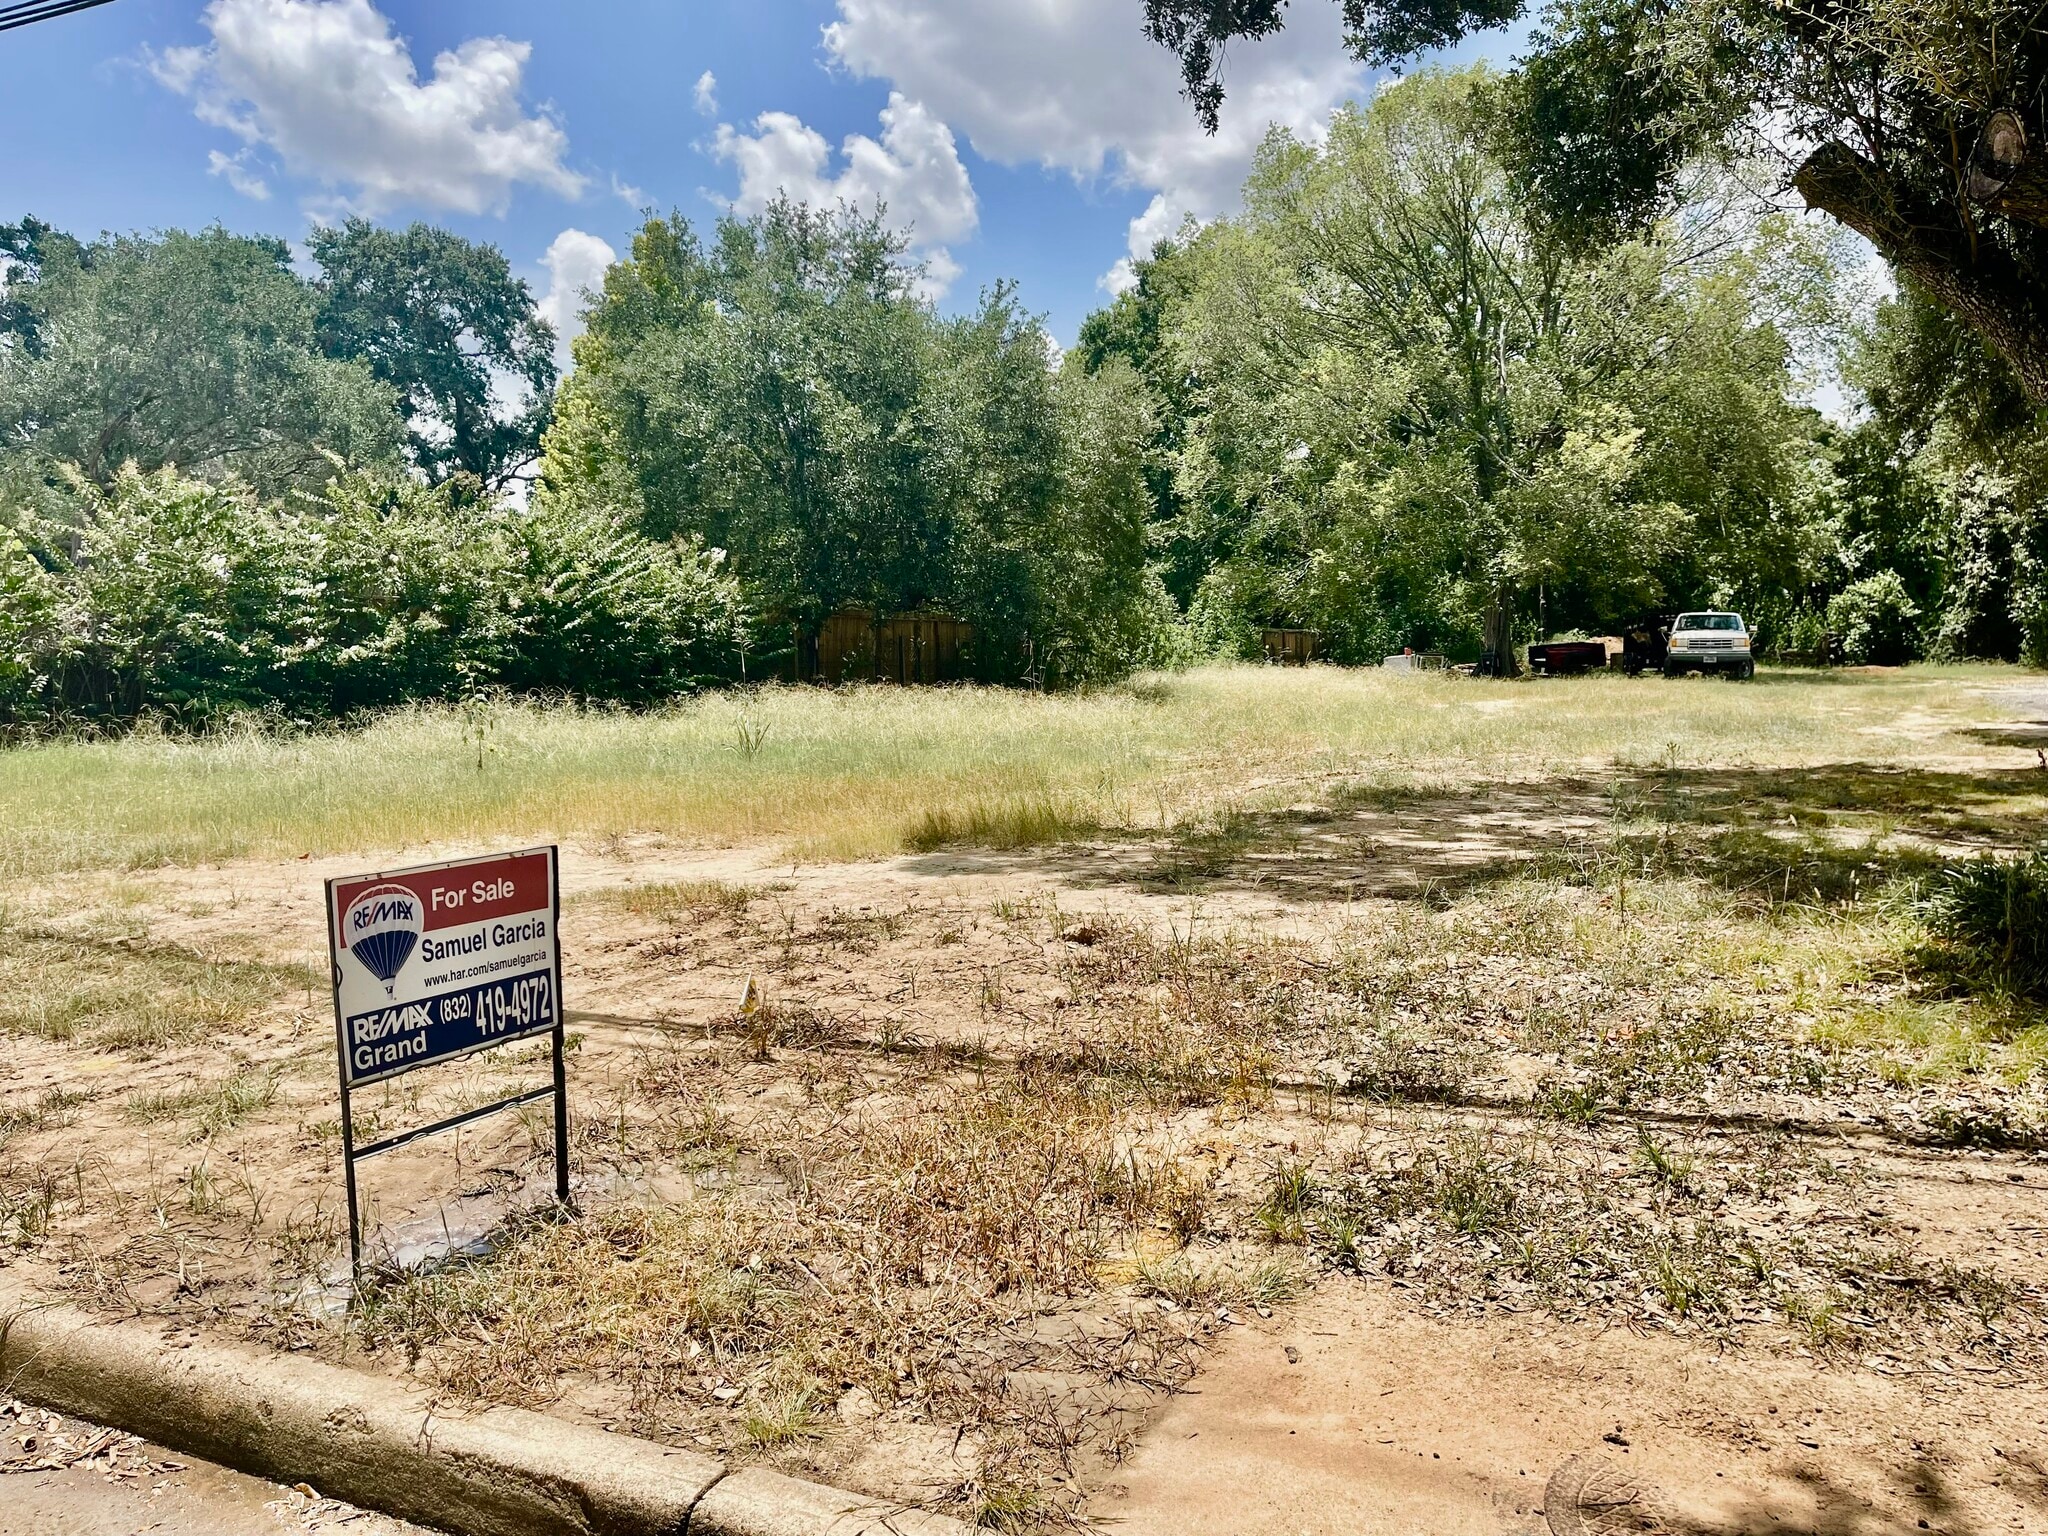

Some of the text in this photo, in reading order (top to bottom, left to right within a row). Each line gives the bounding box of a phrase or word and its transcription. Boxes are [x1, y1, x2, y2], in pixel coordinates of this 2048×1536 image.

[431, 877, 515, 912] For Sale
[353, 900, 414, 931] RE/MAX
[421, 917, 546, 963] Samuel Garcia
[424, 950, 547, 988] www.har.com/samuelgarcia
[353, 1001, 434, 1044] RE/MAX
[439, 974, 551, 1036] (832) 419-4972
[354, 1030, 427, 1070] Grand
